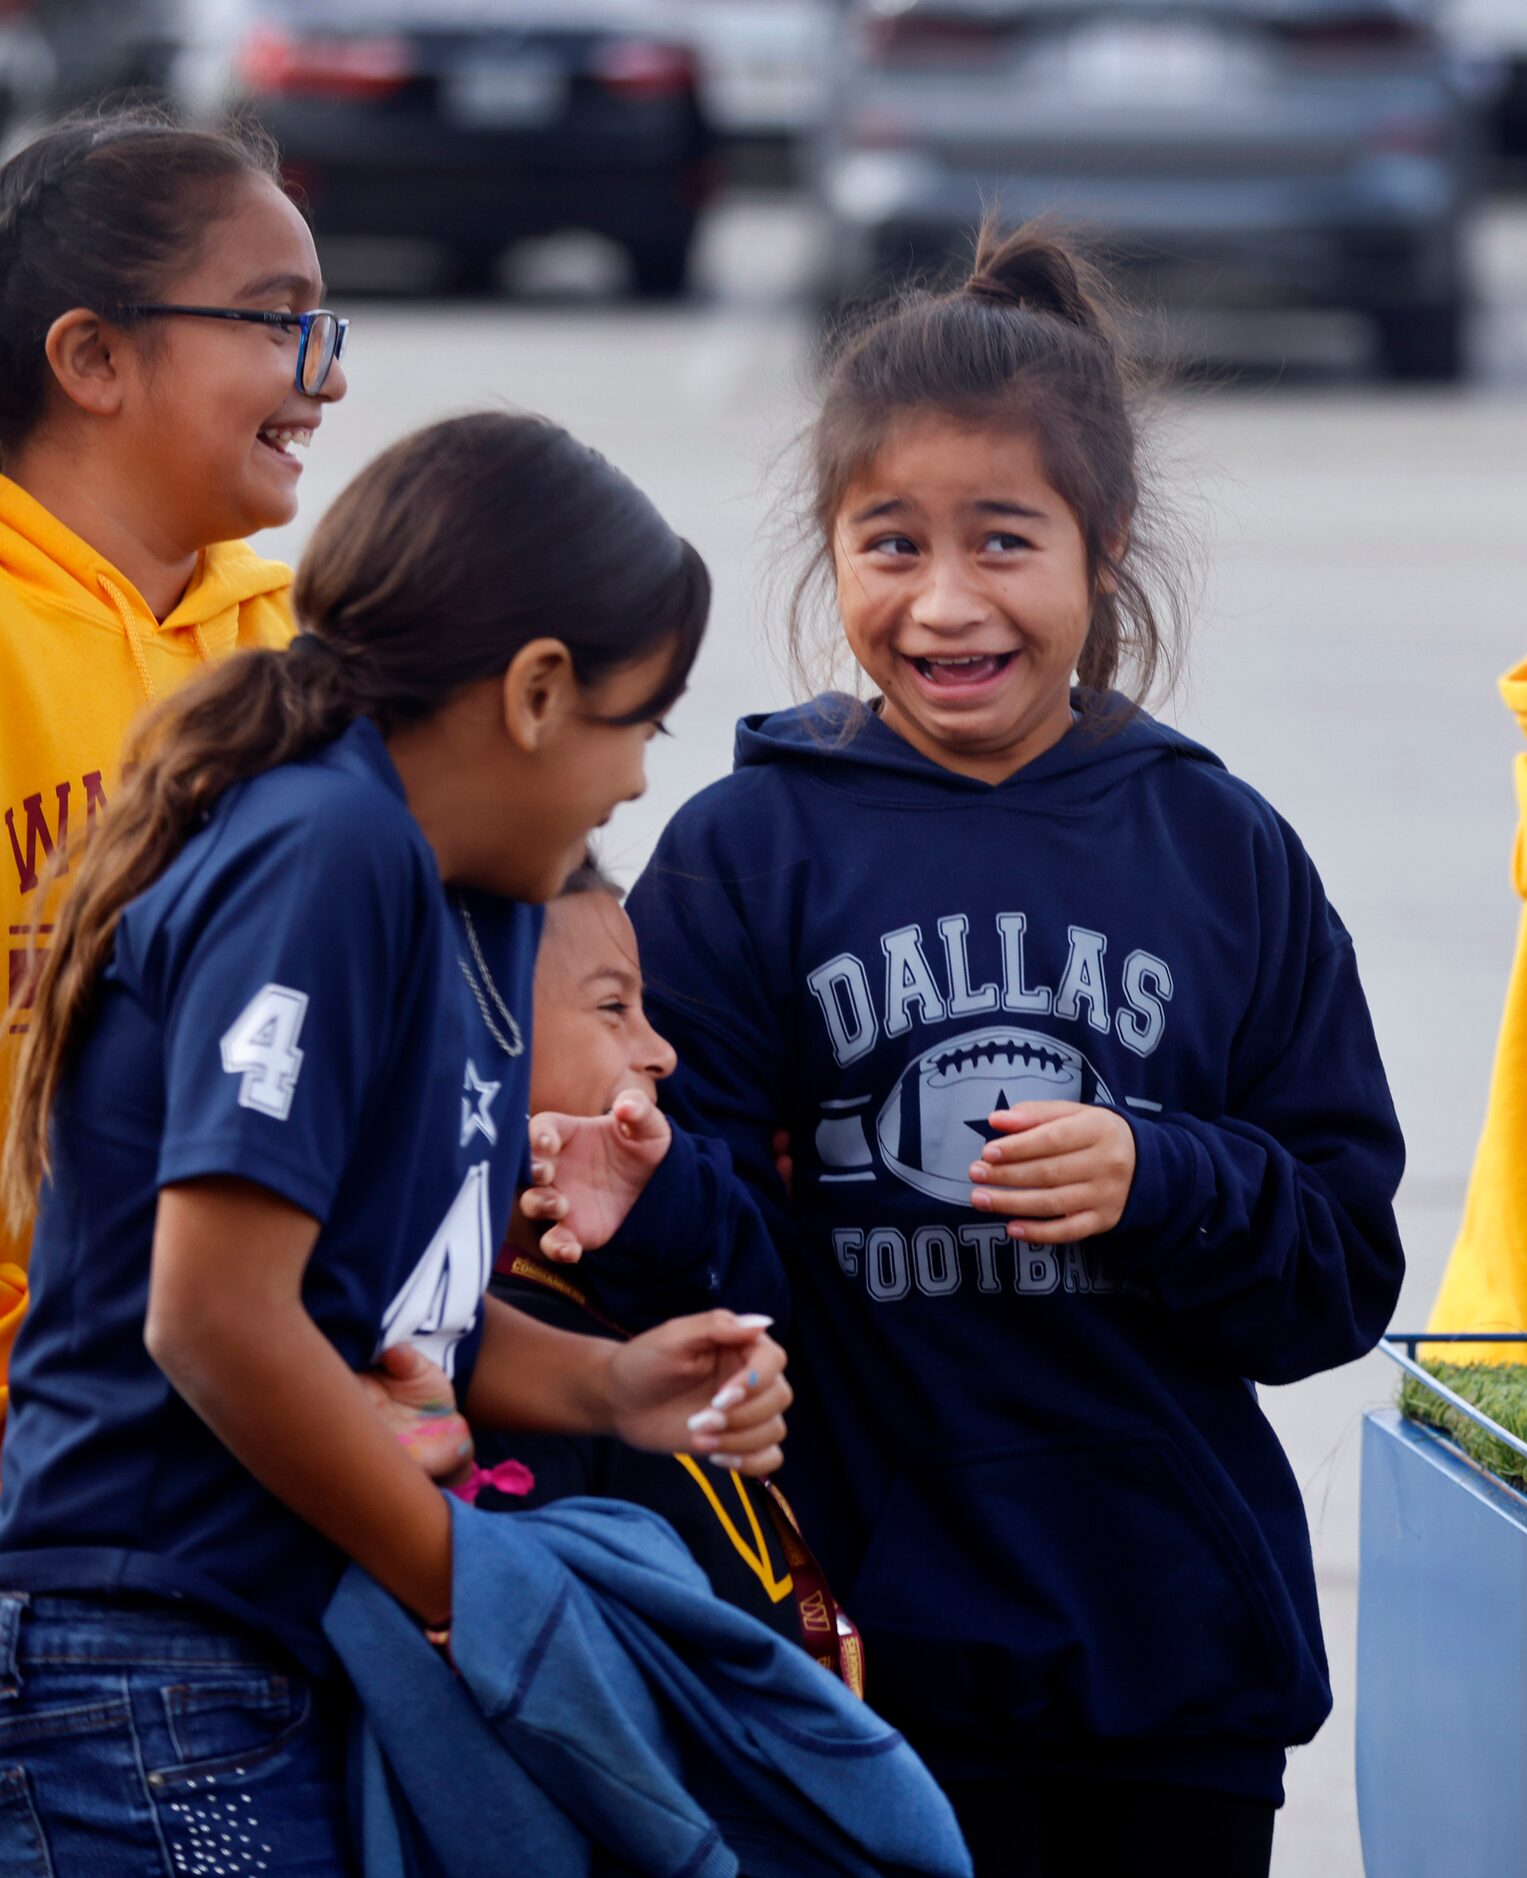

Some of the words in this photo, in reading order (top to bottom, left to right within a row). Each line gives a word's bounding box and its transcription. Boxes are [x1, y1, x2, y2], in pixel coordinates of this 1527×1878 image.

[220, 983, 309, 1121] 4
[807, 912, 1174, 1069] DALLAS
[378, 1160, 491, 1380] 4
